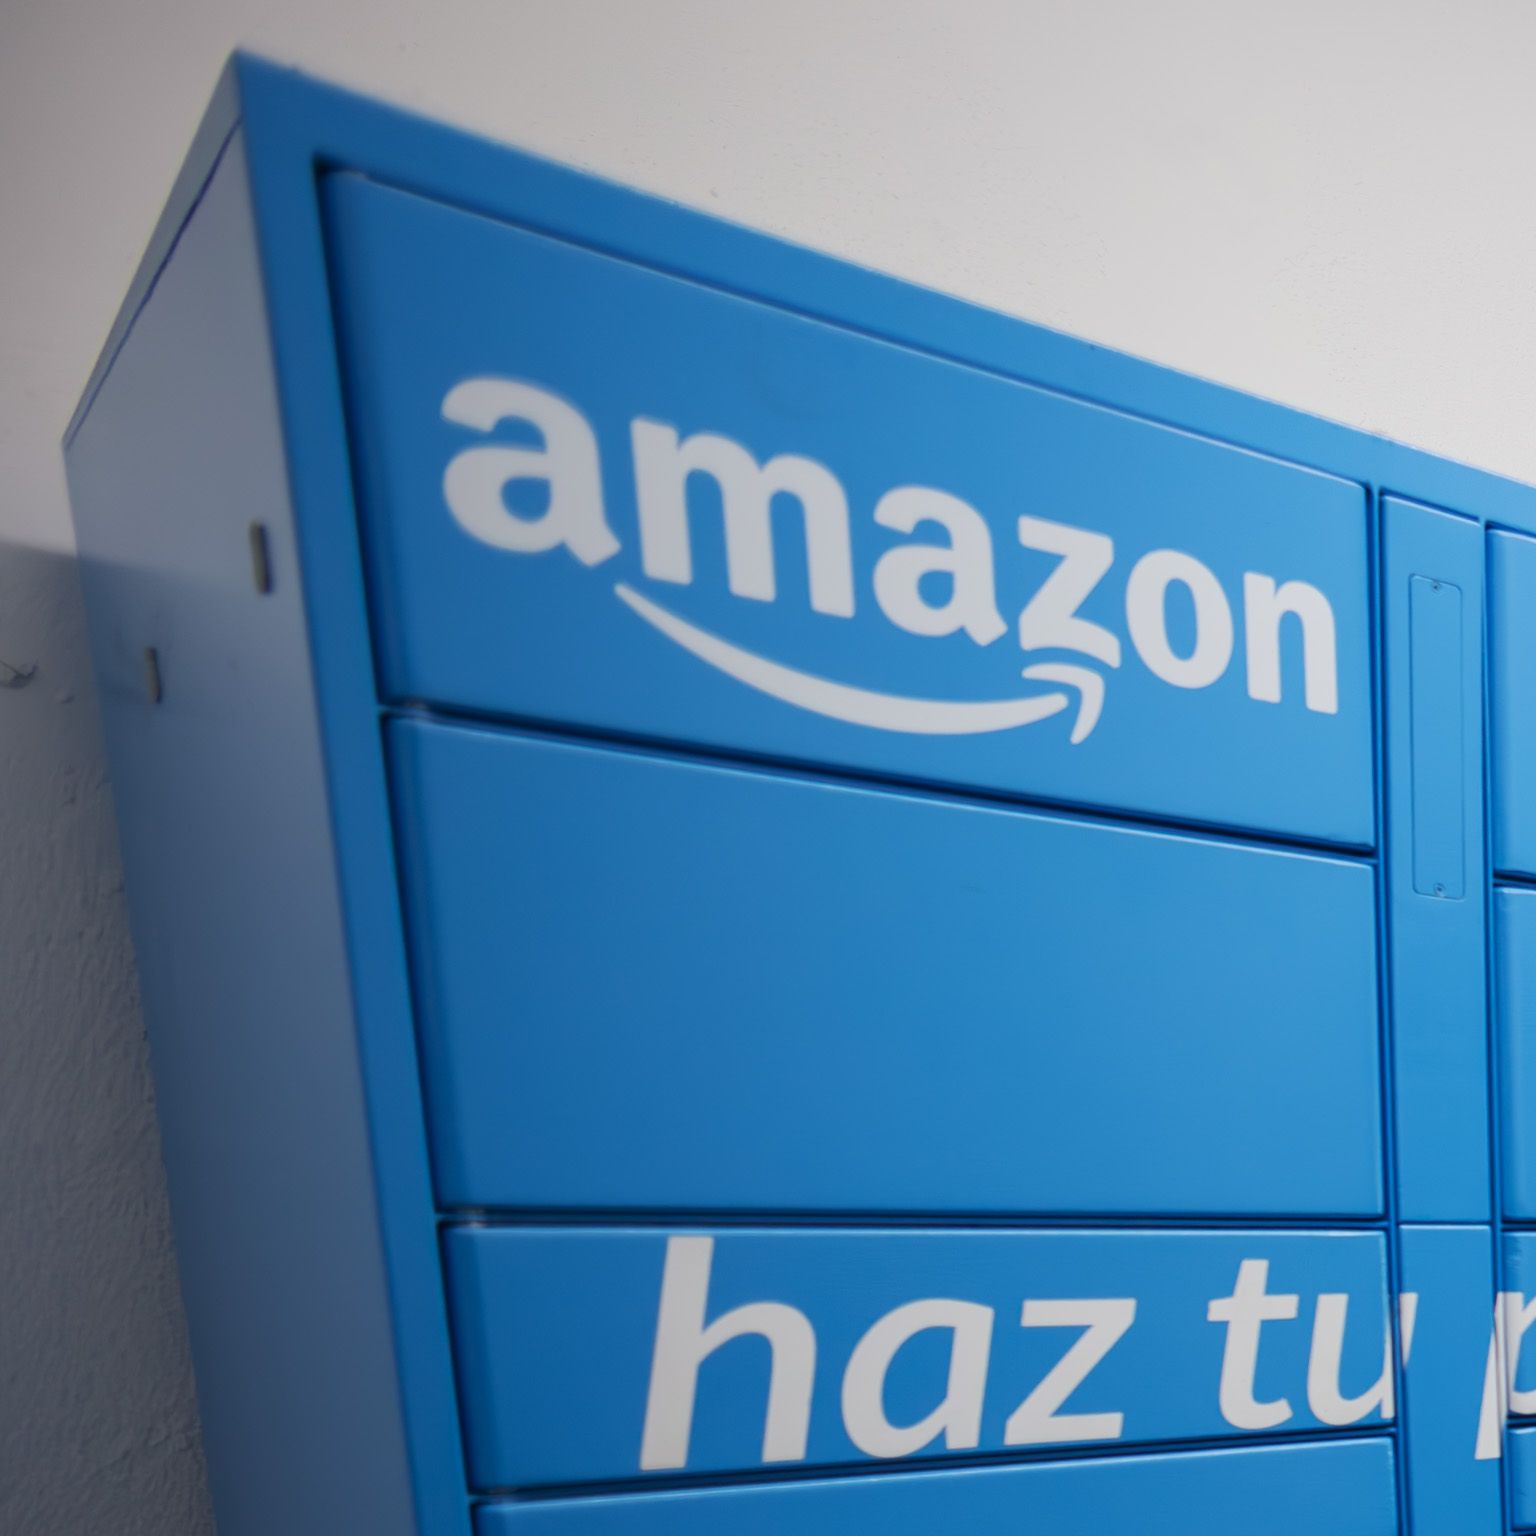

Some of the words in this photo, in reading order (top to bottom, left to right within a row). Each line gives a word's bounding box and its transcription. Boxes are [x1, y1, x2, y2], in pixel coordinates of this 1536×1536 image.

[440, 376, 1338, 716] amazon
[639, 1236, 1137, 1471] haz
[1207, 1258, 1418, 1431] tu
